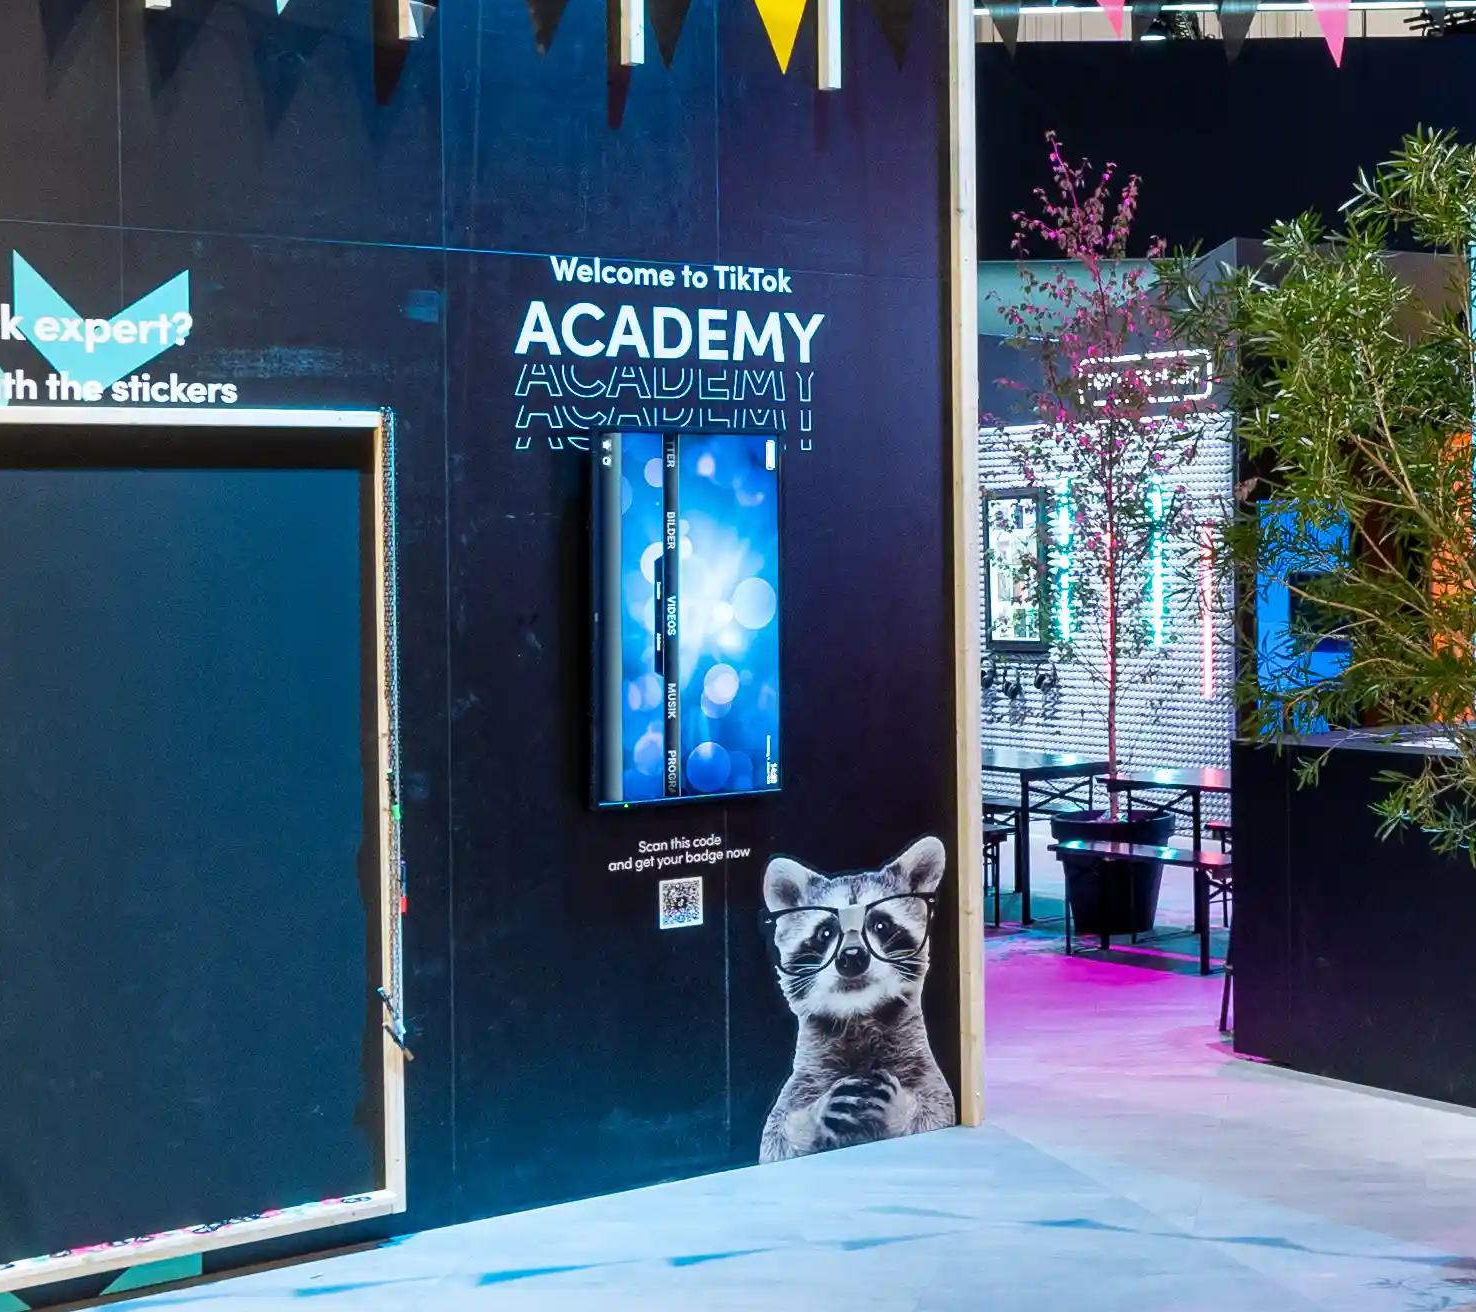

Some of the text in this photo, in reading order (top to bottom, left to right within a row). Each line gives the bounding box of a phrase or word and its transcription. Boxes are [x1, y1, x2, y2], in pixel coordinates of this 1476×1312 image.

[550, 255, 792, 294] Welcome to TikTok
[35, 312, 194, 352] expert?
[514, 301, 824, 364] ACADEMY
[46, 371, 104, 403] the
[111, 374, 239, 405] stickers
[666, 511, 677, 550] BILDER
[666, 596, 677, 636] VIDEOS
[667, 683, 677, 719] MUSIK
[608, 847, 751, 872] and get your badge now
[638, 834, 722, 853] Scan this code
